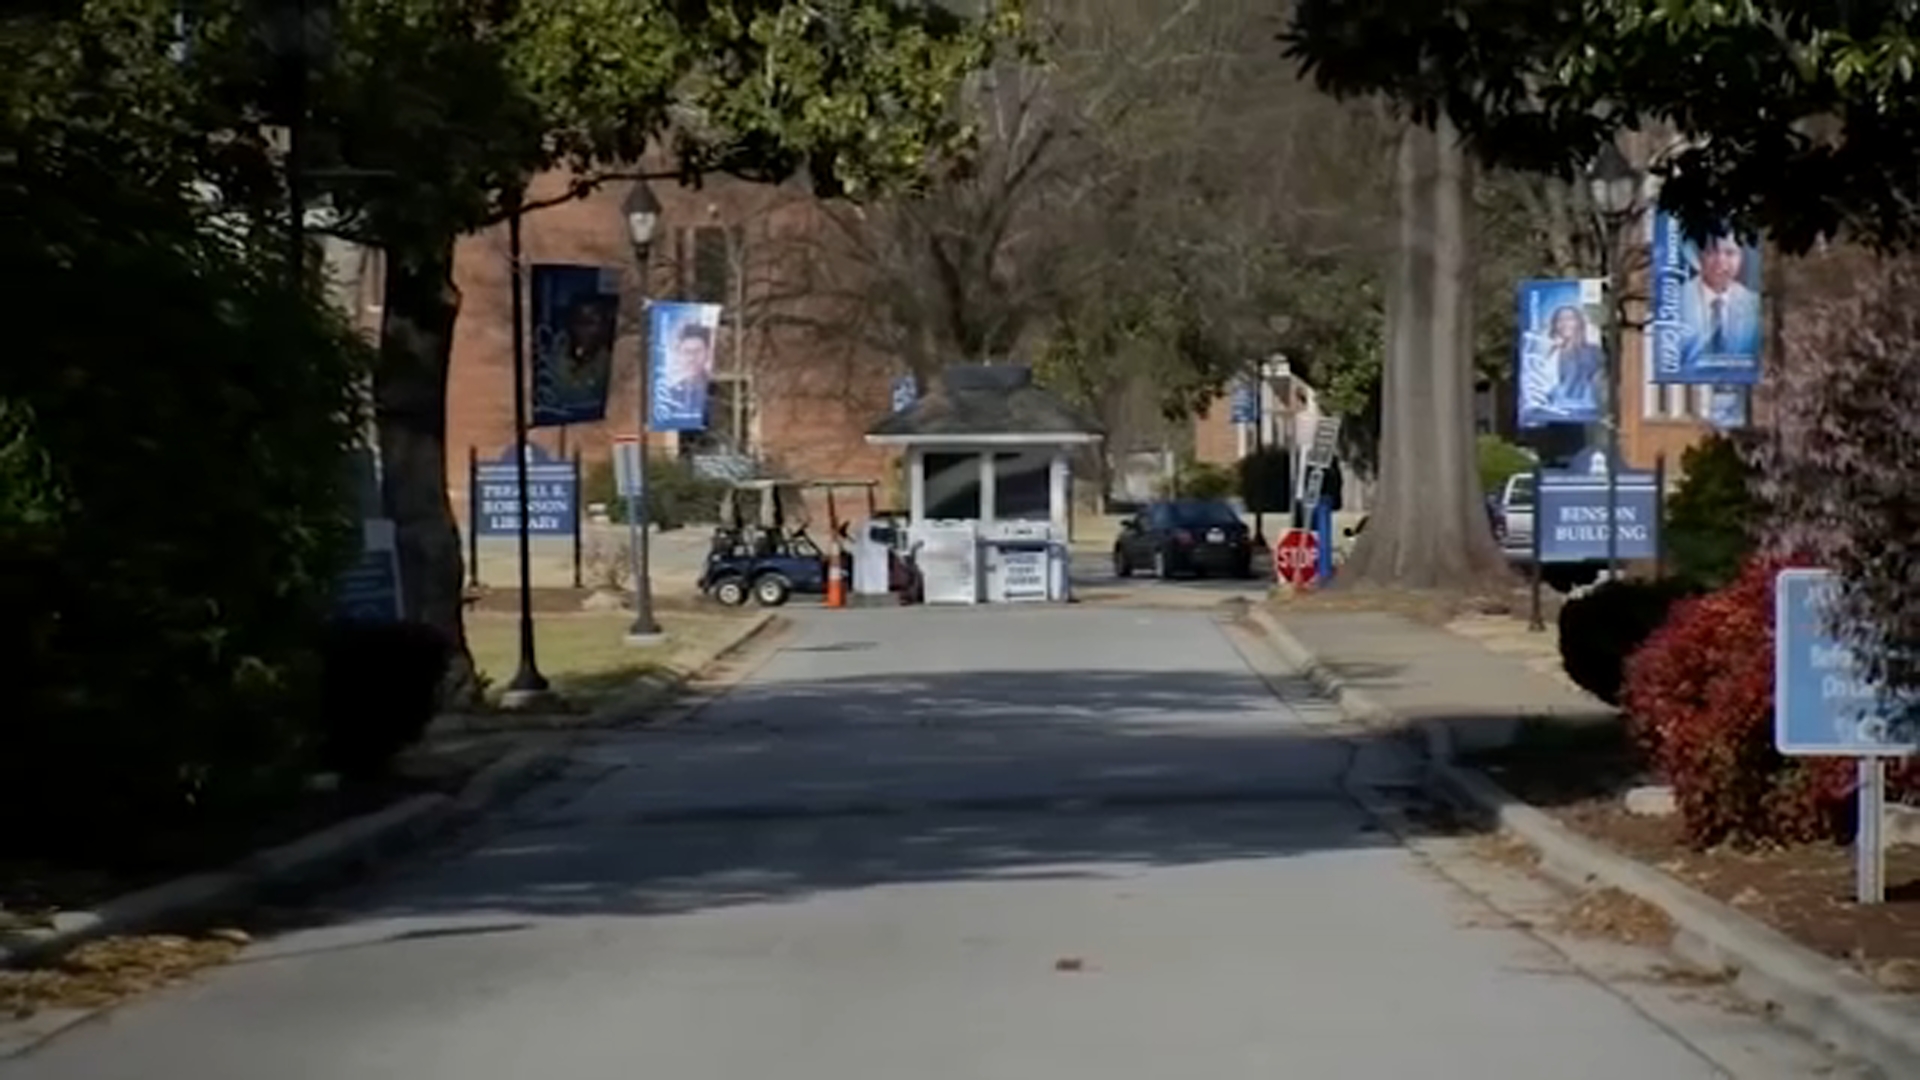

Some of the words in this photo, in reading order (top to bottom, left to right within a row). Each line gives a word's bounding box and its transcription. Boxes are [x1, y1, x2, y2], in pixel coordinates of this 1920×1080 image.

[1655, 264, 1694, 374] Transform
[1555, 525, 1647, 541] BUILDNG
[1279, 547, 1319, 569] STOP
